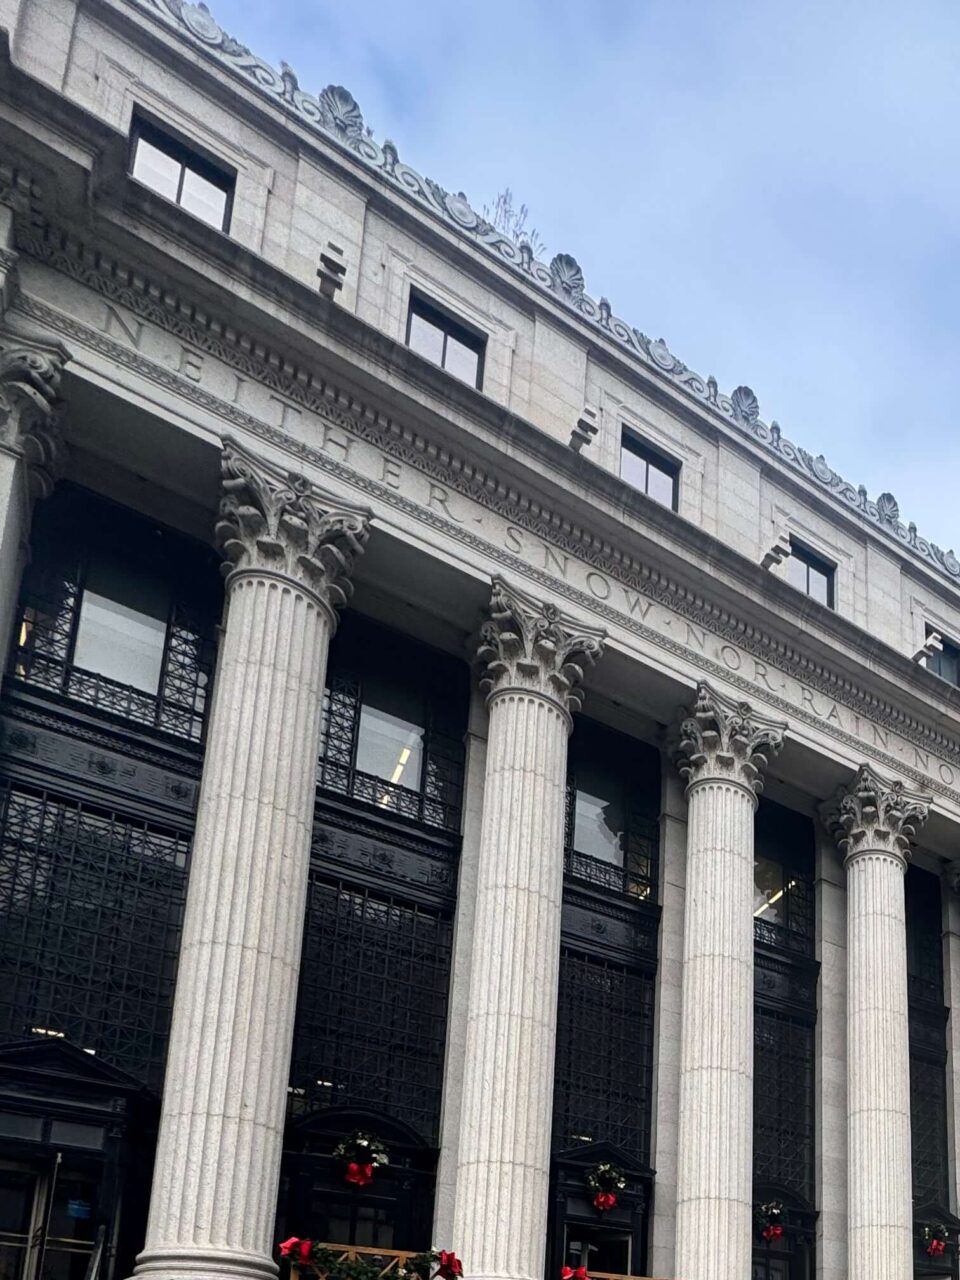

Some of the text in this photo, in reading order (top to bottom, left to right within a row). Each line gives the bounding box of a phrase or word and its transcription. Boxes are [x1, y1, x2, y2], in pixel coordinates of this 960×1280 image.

[104, 303, 464, 523] NEITHER
[504, 526, 654, 621] SNOW
[684, 623, 778, 692] NOR
[800, 686, 890, 751] RAIN
